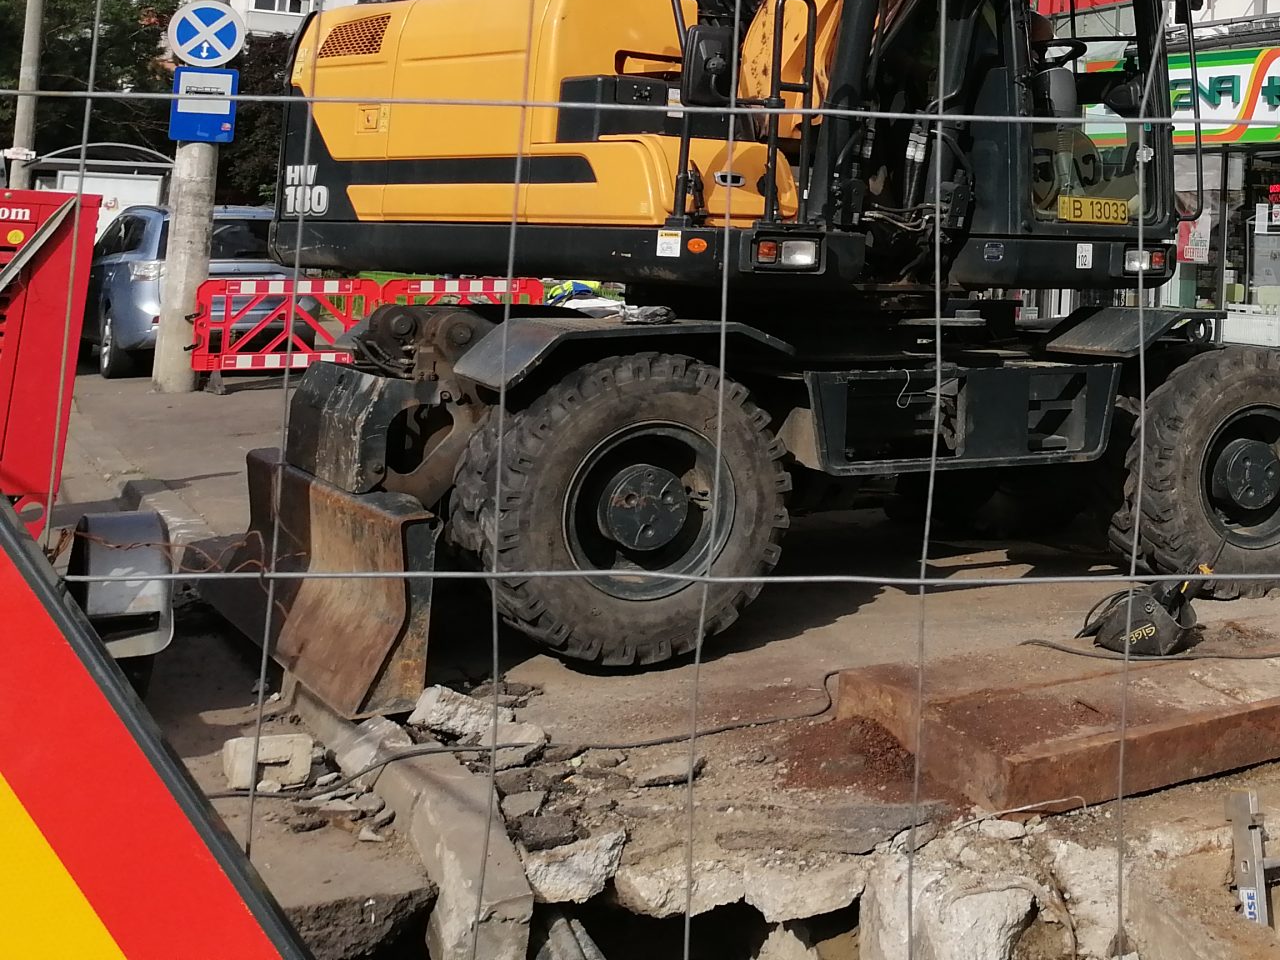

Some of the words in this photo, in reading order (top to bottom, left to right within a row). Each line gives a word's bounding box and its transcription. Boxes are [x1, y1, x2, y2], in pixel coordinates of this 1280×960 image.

[286, 164, 318, 186] HW
[284, 185, 329, 216] 180
[1072, 199, 1083, 219] B
[1089, 201, 1127, 221] 13033
